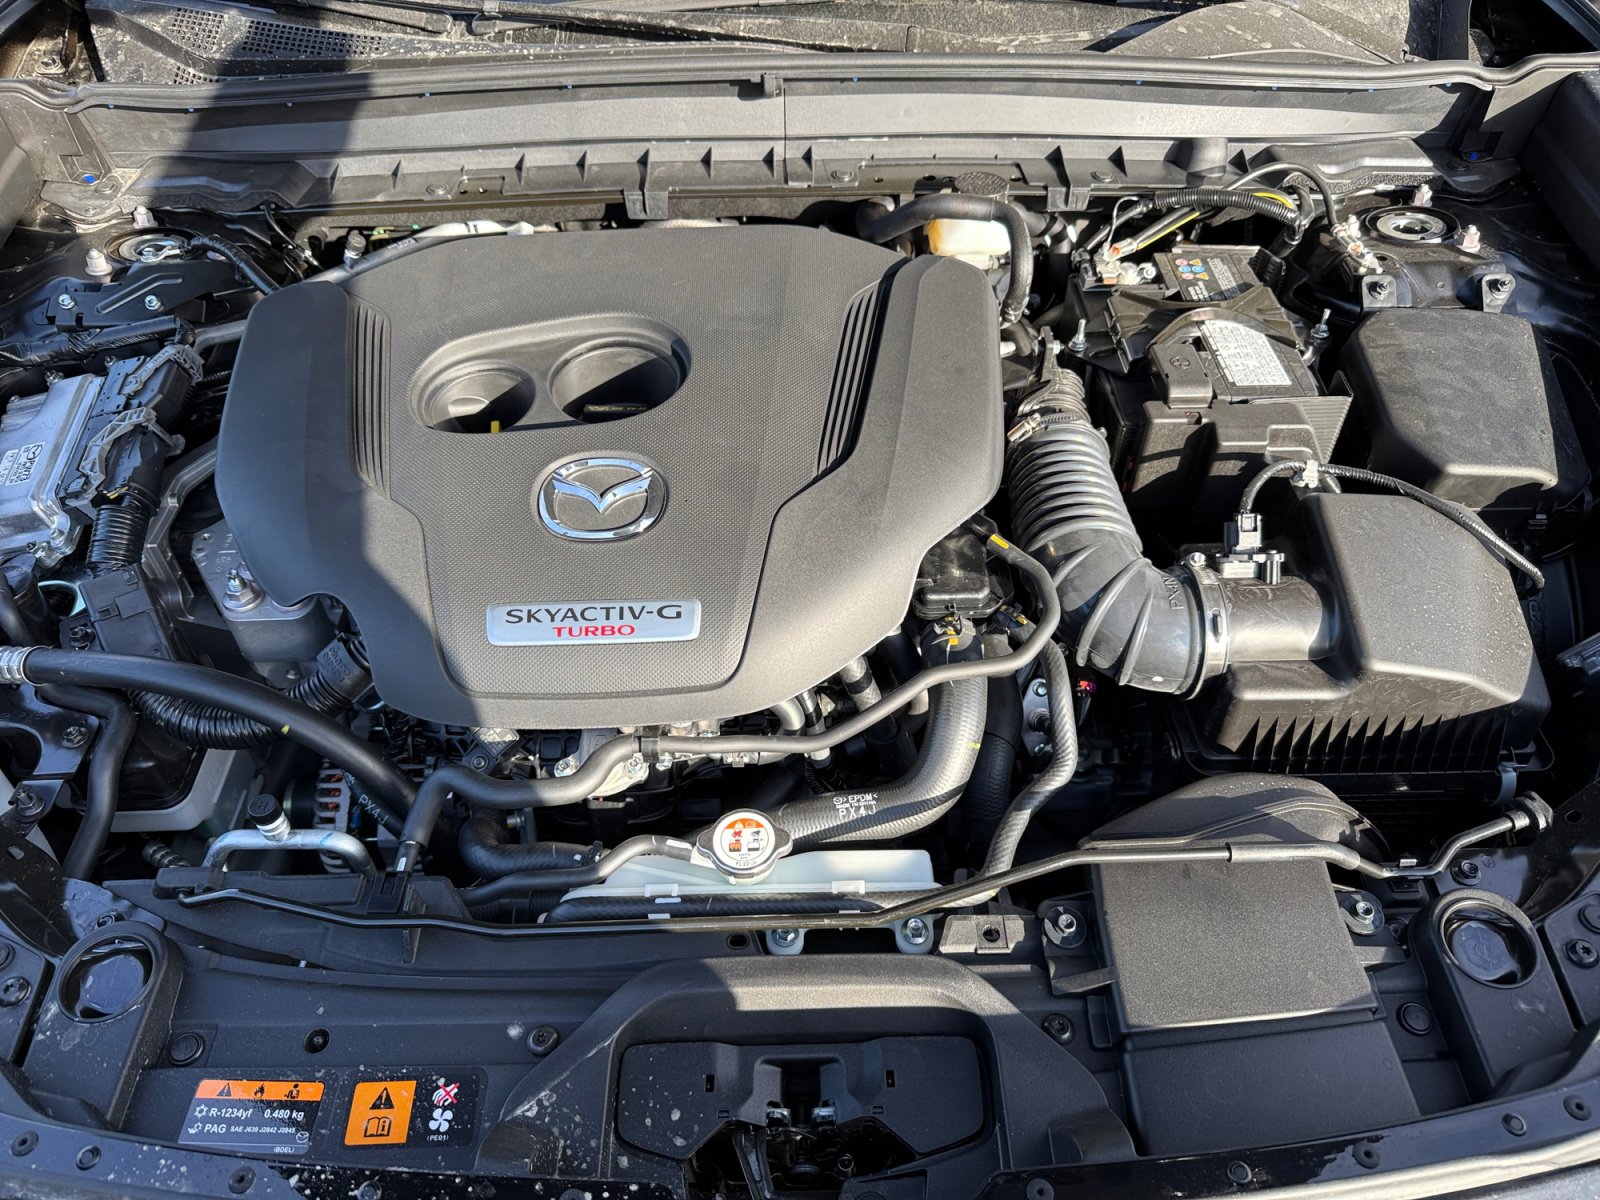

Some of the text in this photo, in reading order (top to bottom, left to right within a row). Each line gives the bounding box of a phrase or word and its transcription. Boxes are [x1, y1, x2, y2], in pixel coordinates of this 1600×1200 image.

[505, 604, 682, 624] SKYACTIV-G
[552, 624, 635, 638] TURBO
[358, 793, 390, 824] PX4J
[838, 805, 876, 820] PX4J
[209, 1107, 305, 1121] R-1234yf 0.480 kg
[204, 1124, 227, 1134] PAG
[230, 1125, 243, 1133] SAE
